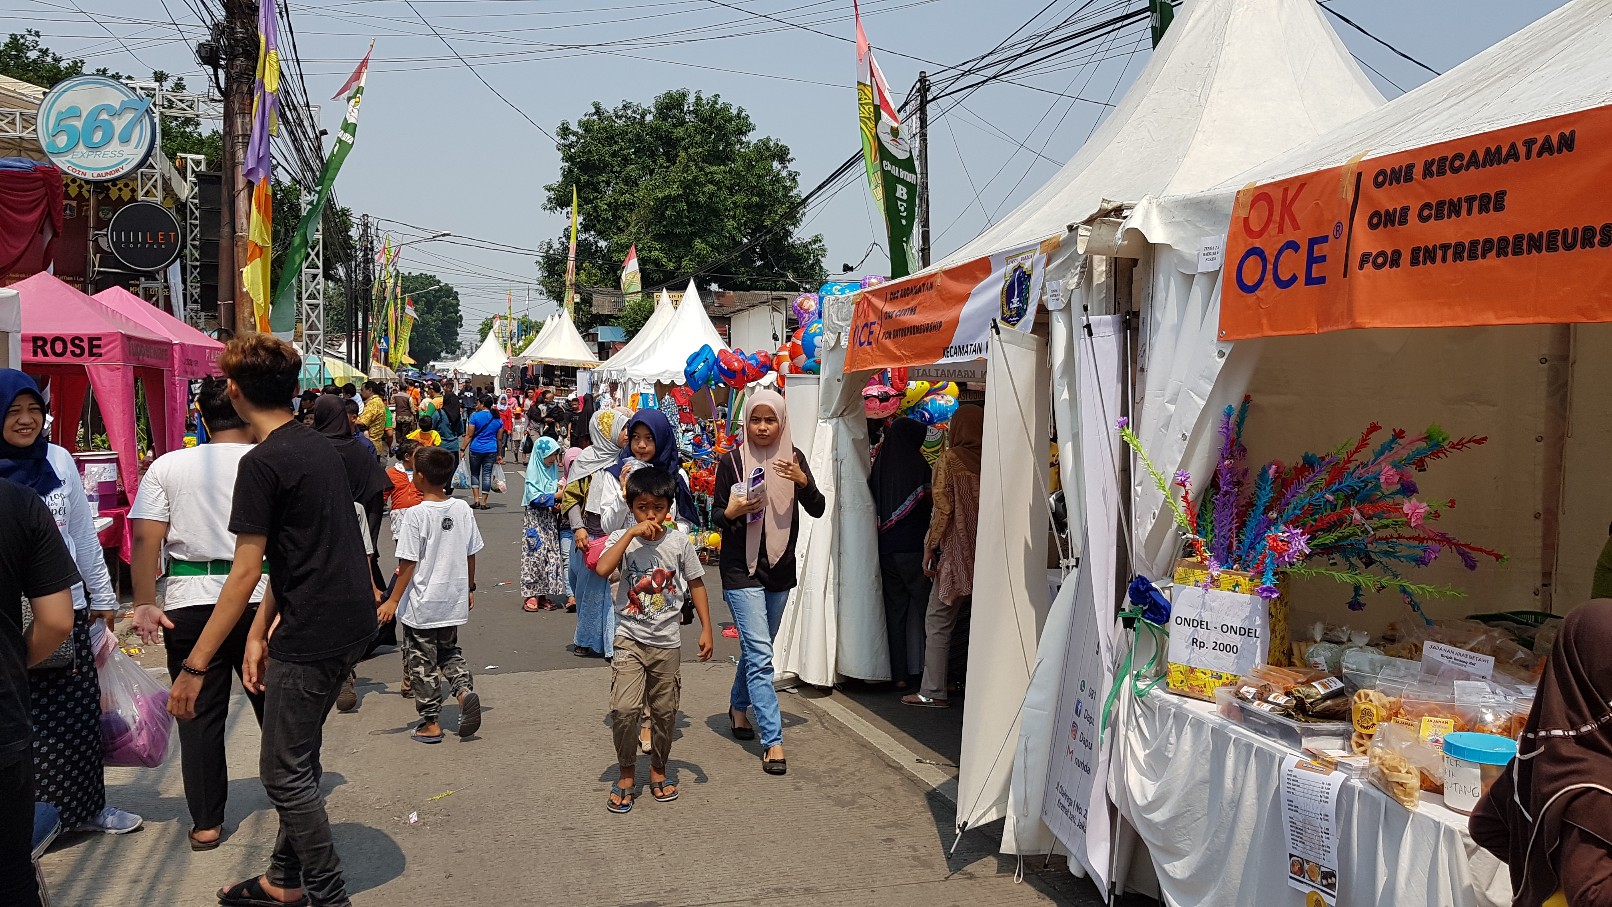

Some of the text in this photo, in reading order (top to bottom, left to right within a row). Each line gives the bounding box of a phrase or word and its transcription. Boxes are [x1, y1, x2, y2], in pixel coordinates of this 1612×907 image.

[45, 96, 152, 154] 567
[71, 149, 125, 159] EXPRESS
[1372, 129, 1577, 189] ONE KECAMATAN
[66, 165, 125, 178] COIN LAUNDRY
[1242, 181, 1307, 240] OK
[1367, 189, 1508, 231] ONE CENTRE
[1357, 221, 1612, 272] FOR ENTREPRENEURS
[1235, 233, 1330, 295] OCE
[31, 335, 103, 358] ROSE
[942, 341, 983, 359] KECAMATAN
[1174, 615, 1211, 631] ONDEL
[1220, 623, 1261, 639] ONDEL
[1191, 637, 1239, 655] Rp. 2000
